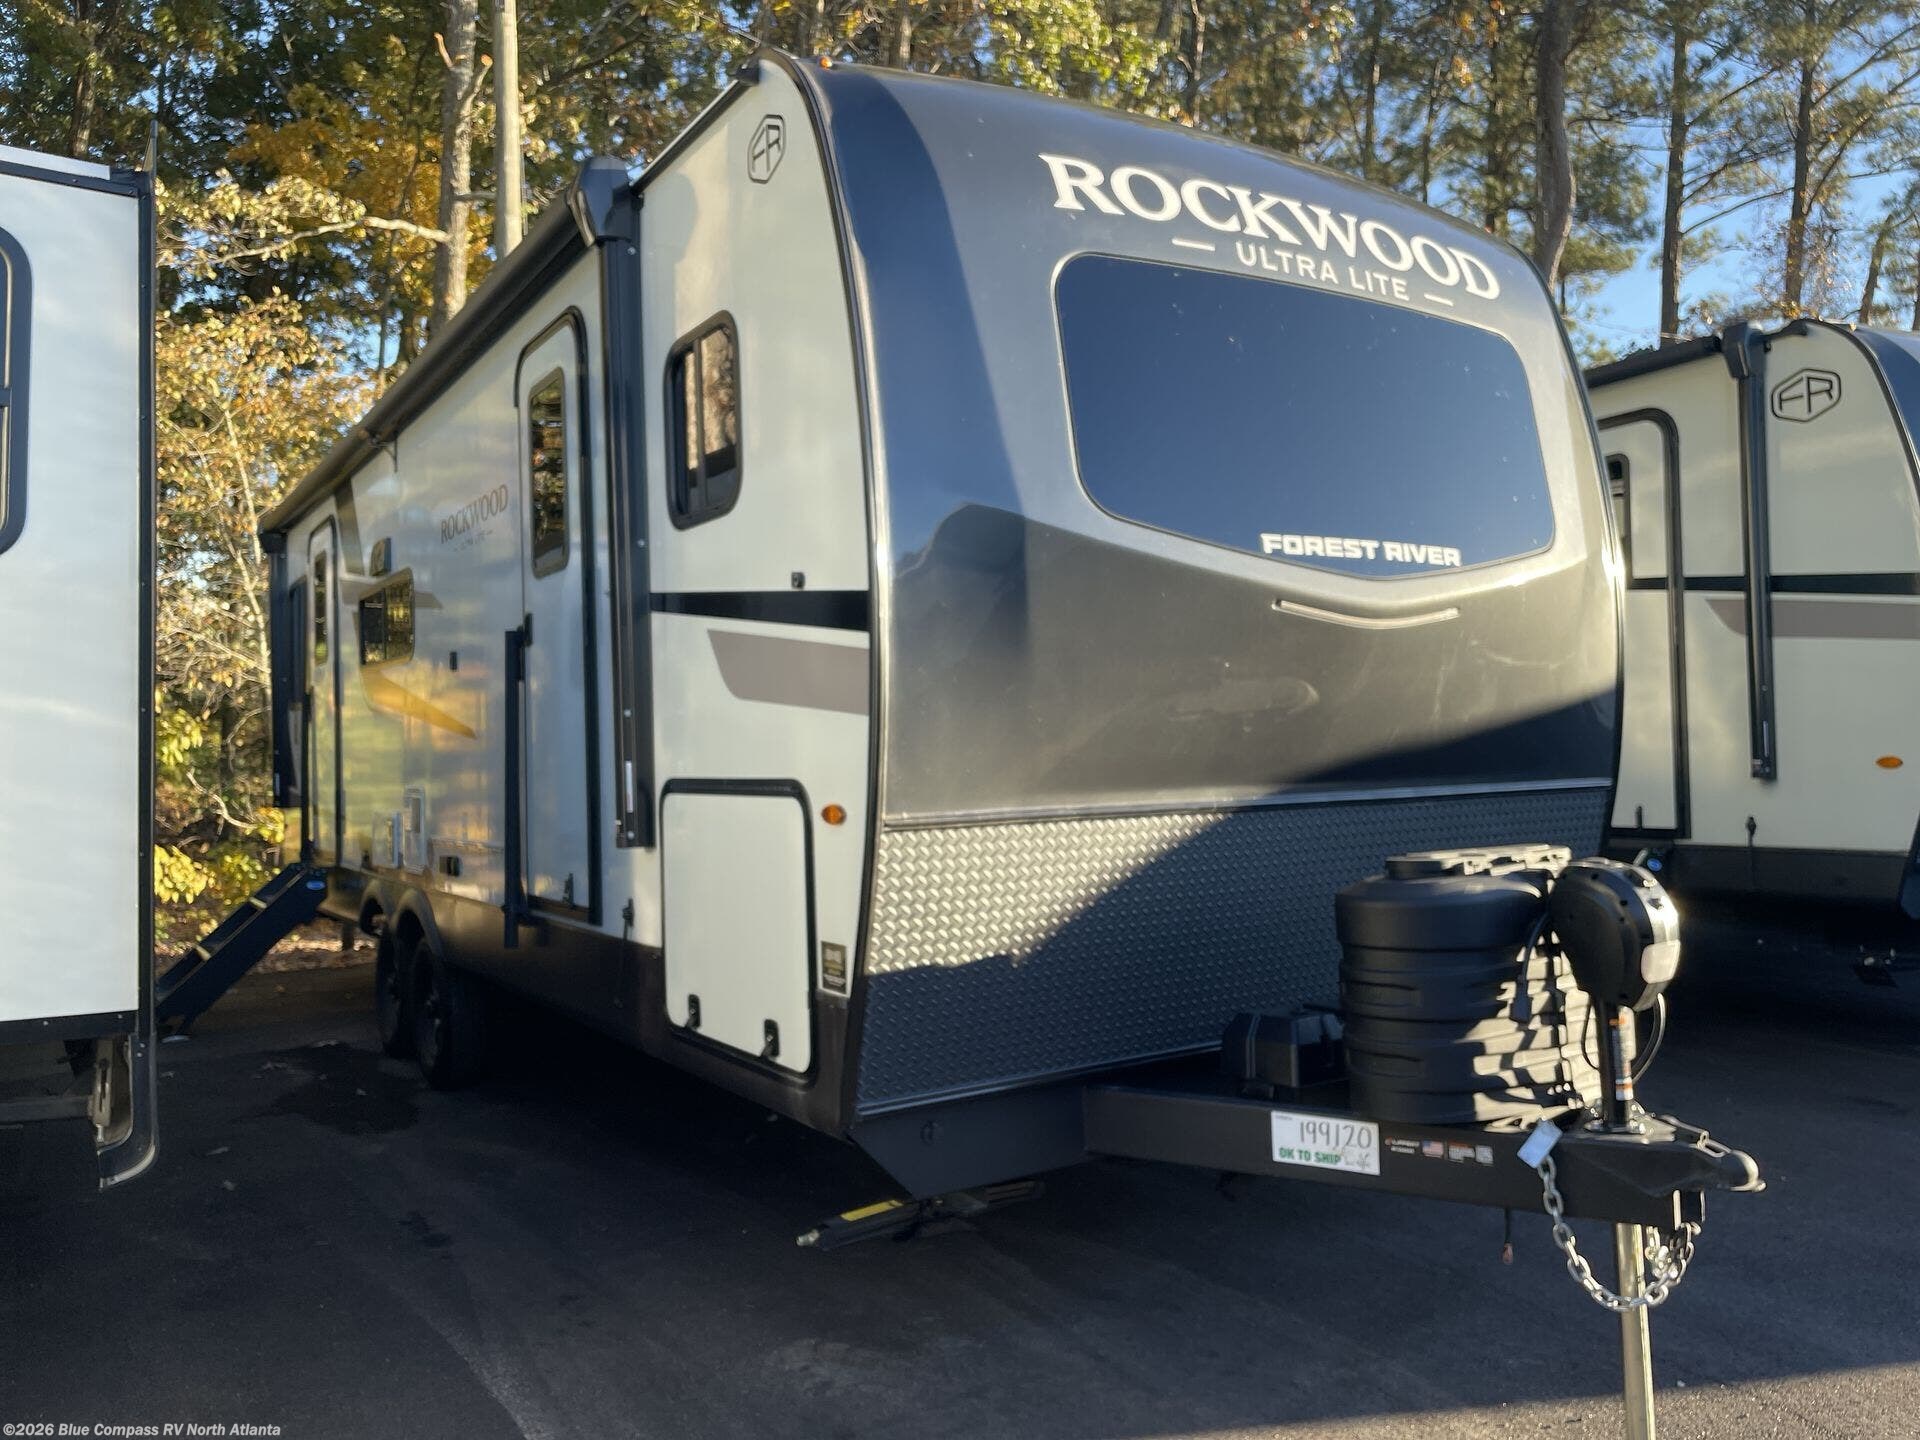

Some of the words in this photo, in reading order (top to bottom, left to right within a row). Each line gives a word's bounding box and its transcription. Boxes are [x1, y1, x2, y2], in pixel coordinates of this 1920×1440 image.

[1039, 153, 1500, 300] ROCKWOOD
[1235, 240, 1339, 285] ULTRA
[1348, 265, 1410, 301] LITE
[441, 484, 508, 545] ROCKWOOD
[1260, 532, 1379, 560] FOREST
[1382, 540, 1462, 567] RIVER
[1279, 1146, 1294, 1160] OK
[1298, 1149, 1311, 1162] TO
[1314, 1151, 1341, 1166] SHIP
[1300, 1120, 1373, 1150] 199120
